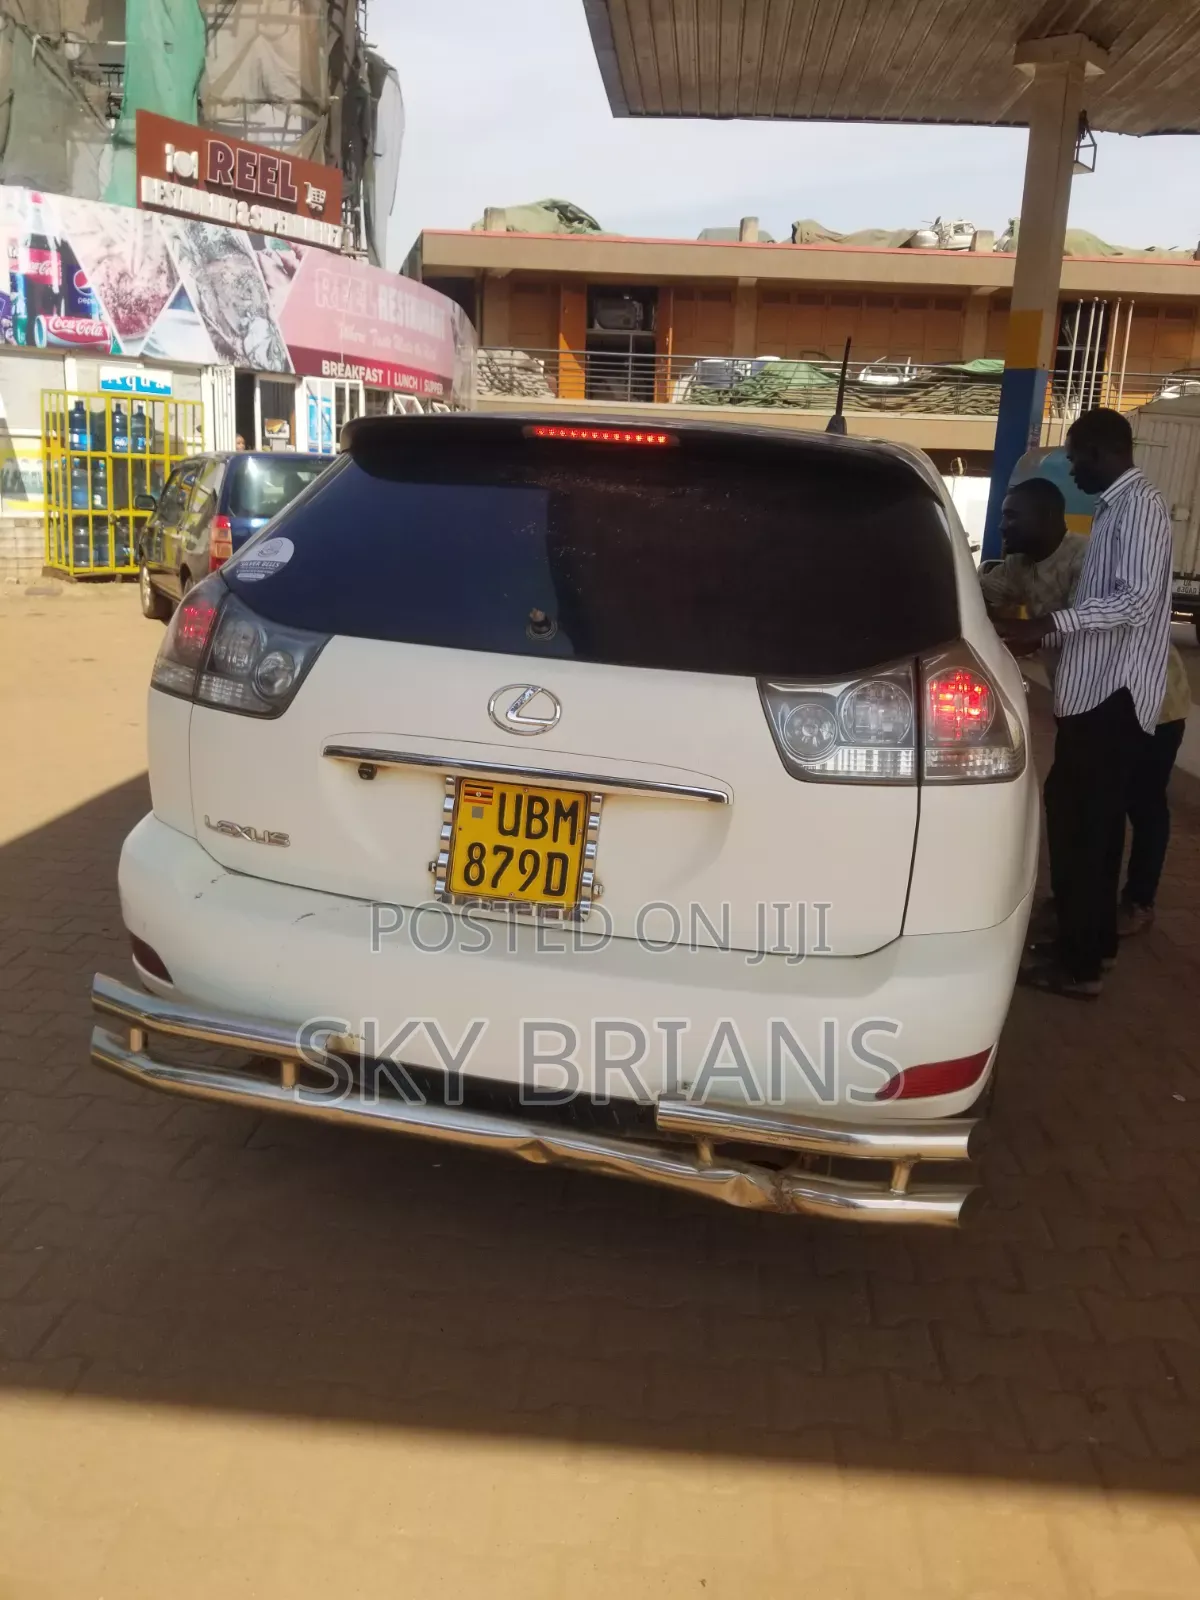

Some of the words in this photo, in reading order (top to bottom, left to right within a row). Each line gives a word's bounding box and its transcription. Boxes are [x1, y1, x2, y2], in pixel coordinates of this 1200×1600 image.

[207, 140, 297, 202] REEL
[316, 268, 376, 318] REEL
[321, 359, 384, 384] BREAKFAST
[393, 371, 418, 390] LUNCH
[423, 379, 444, 395] SUPPER
[204, 814, 290, 848] LEXUS
[498, 792, 579, 846] UBM
[463, 842, 569, 896] 879D
